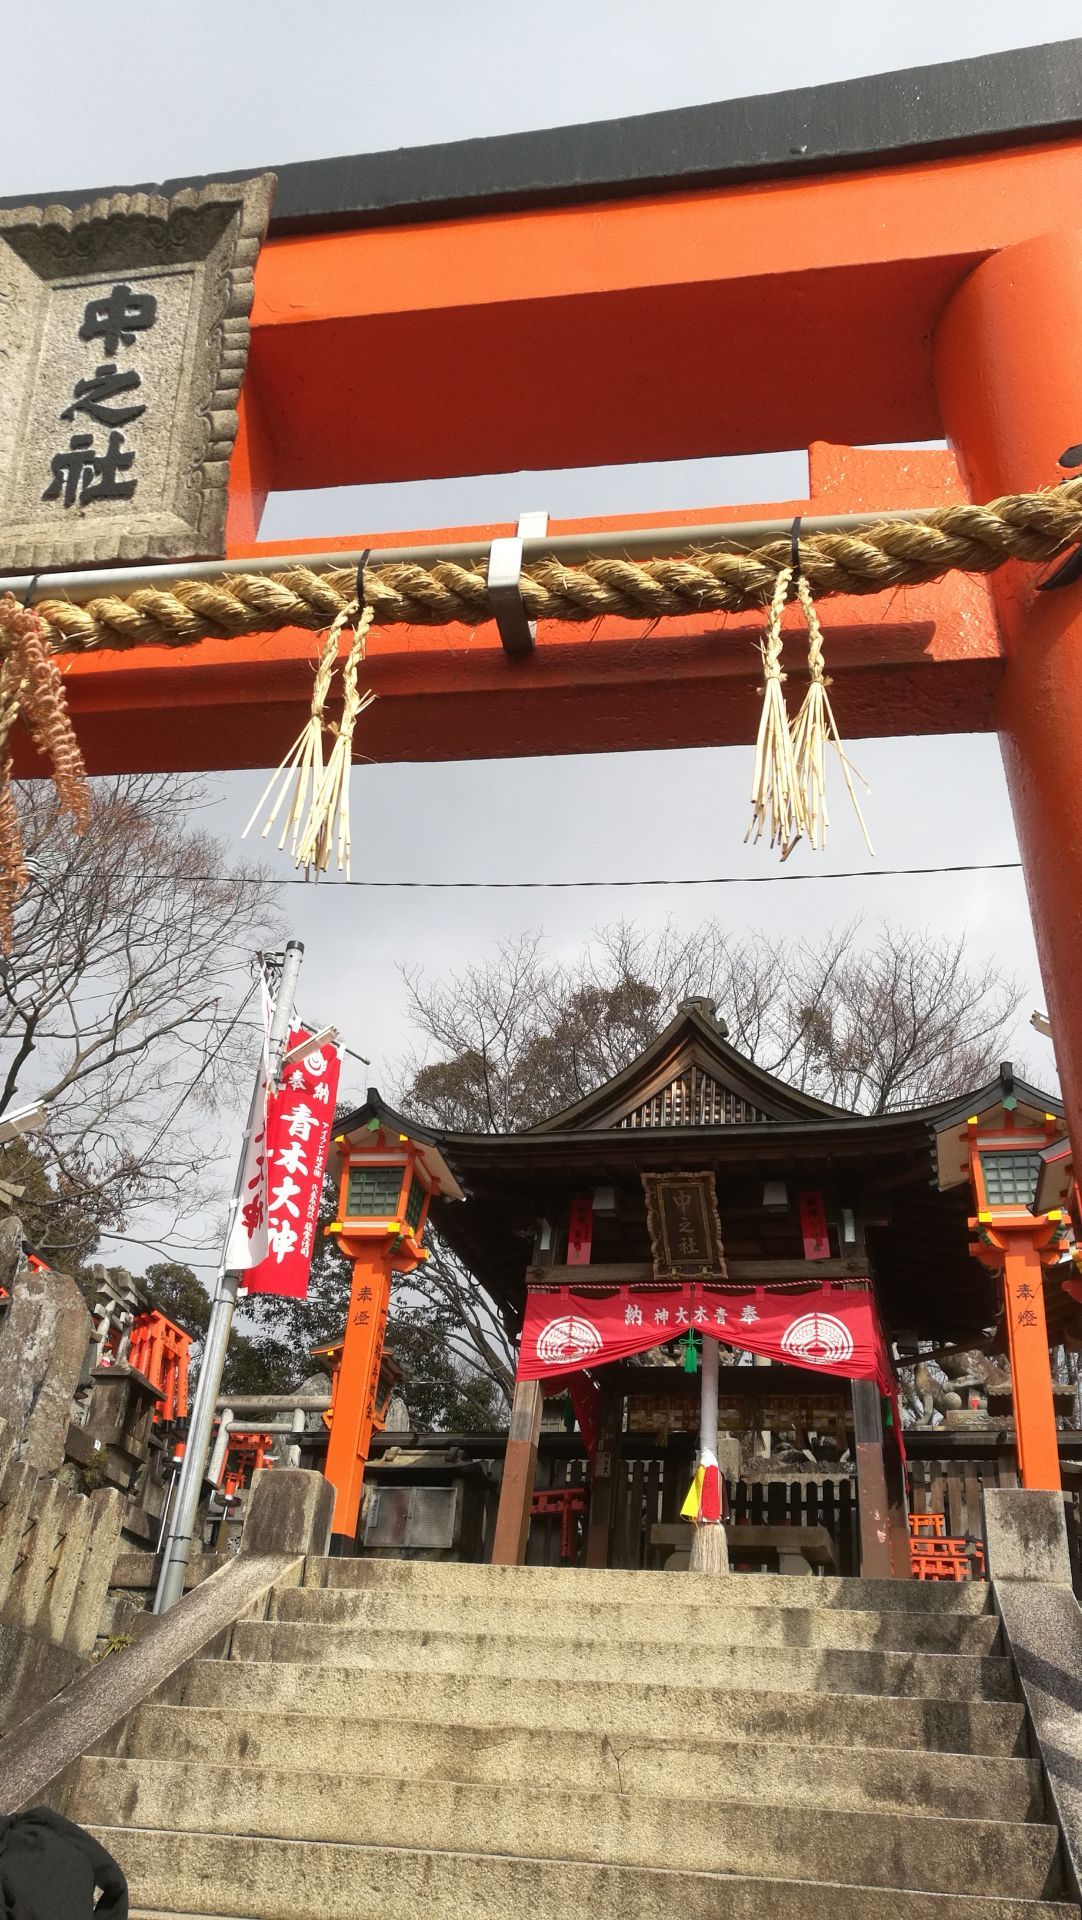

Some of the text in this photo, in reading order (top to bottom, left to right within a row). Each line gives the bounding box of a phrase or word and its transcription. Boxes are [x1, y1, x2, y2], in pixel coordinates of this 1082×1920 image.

[42, 285, 157, 507] 中之社
[268, 1103, 320, 1265] 青木大神
[672, 1191, 699, 1255] 中之社
